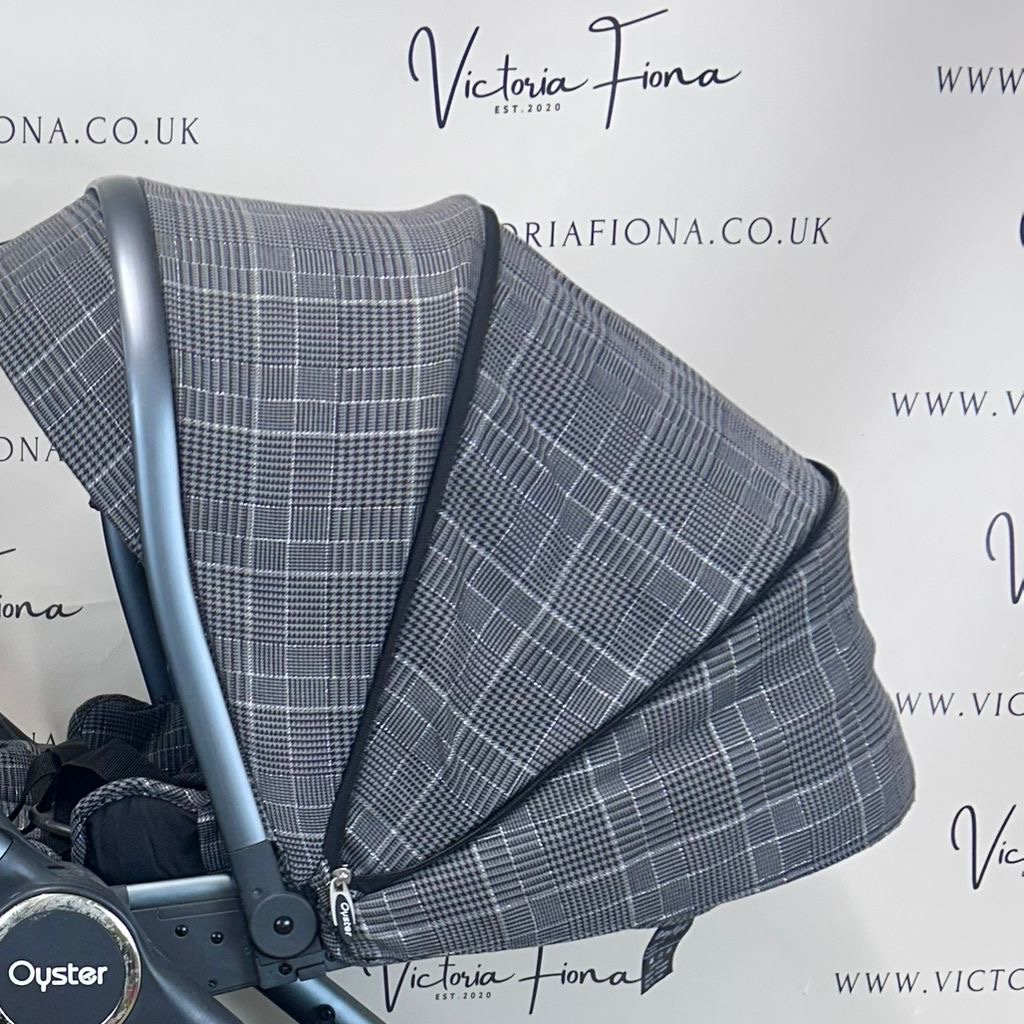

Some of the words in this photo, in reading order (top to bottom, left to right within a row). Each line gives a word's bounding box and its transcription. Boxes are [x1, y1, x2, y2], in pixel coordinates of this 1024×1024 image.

[408, 25, 590, 130] Victoria
[588, 8, 742, 130] Fiona
[494, 103, 561, 114] EST.2020
[8, 959, 108, 992] Oyster
